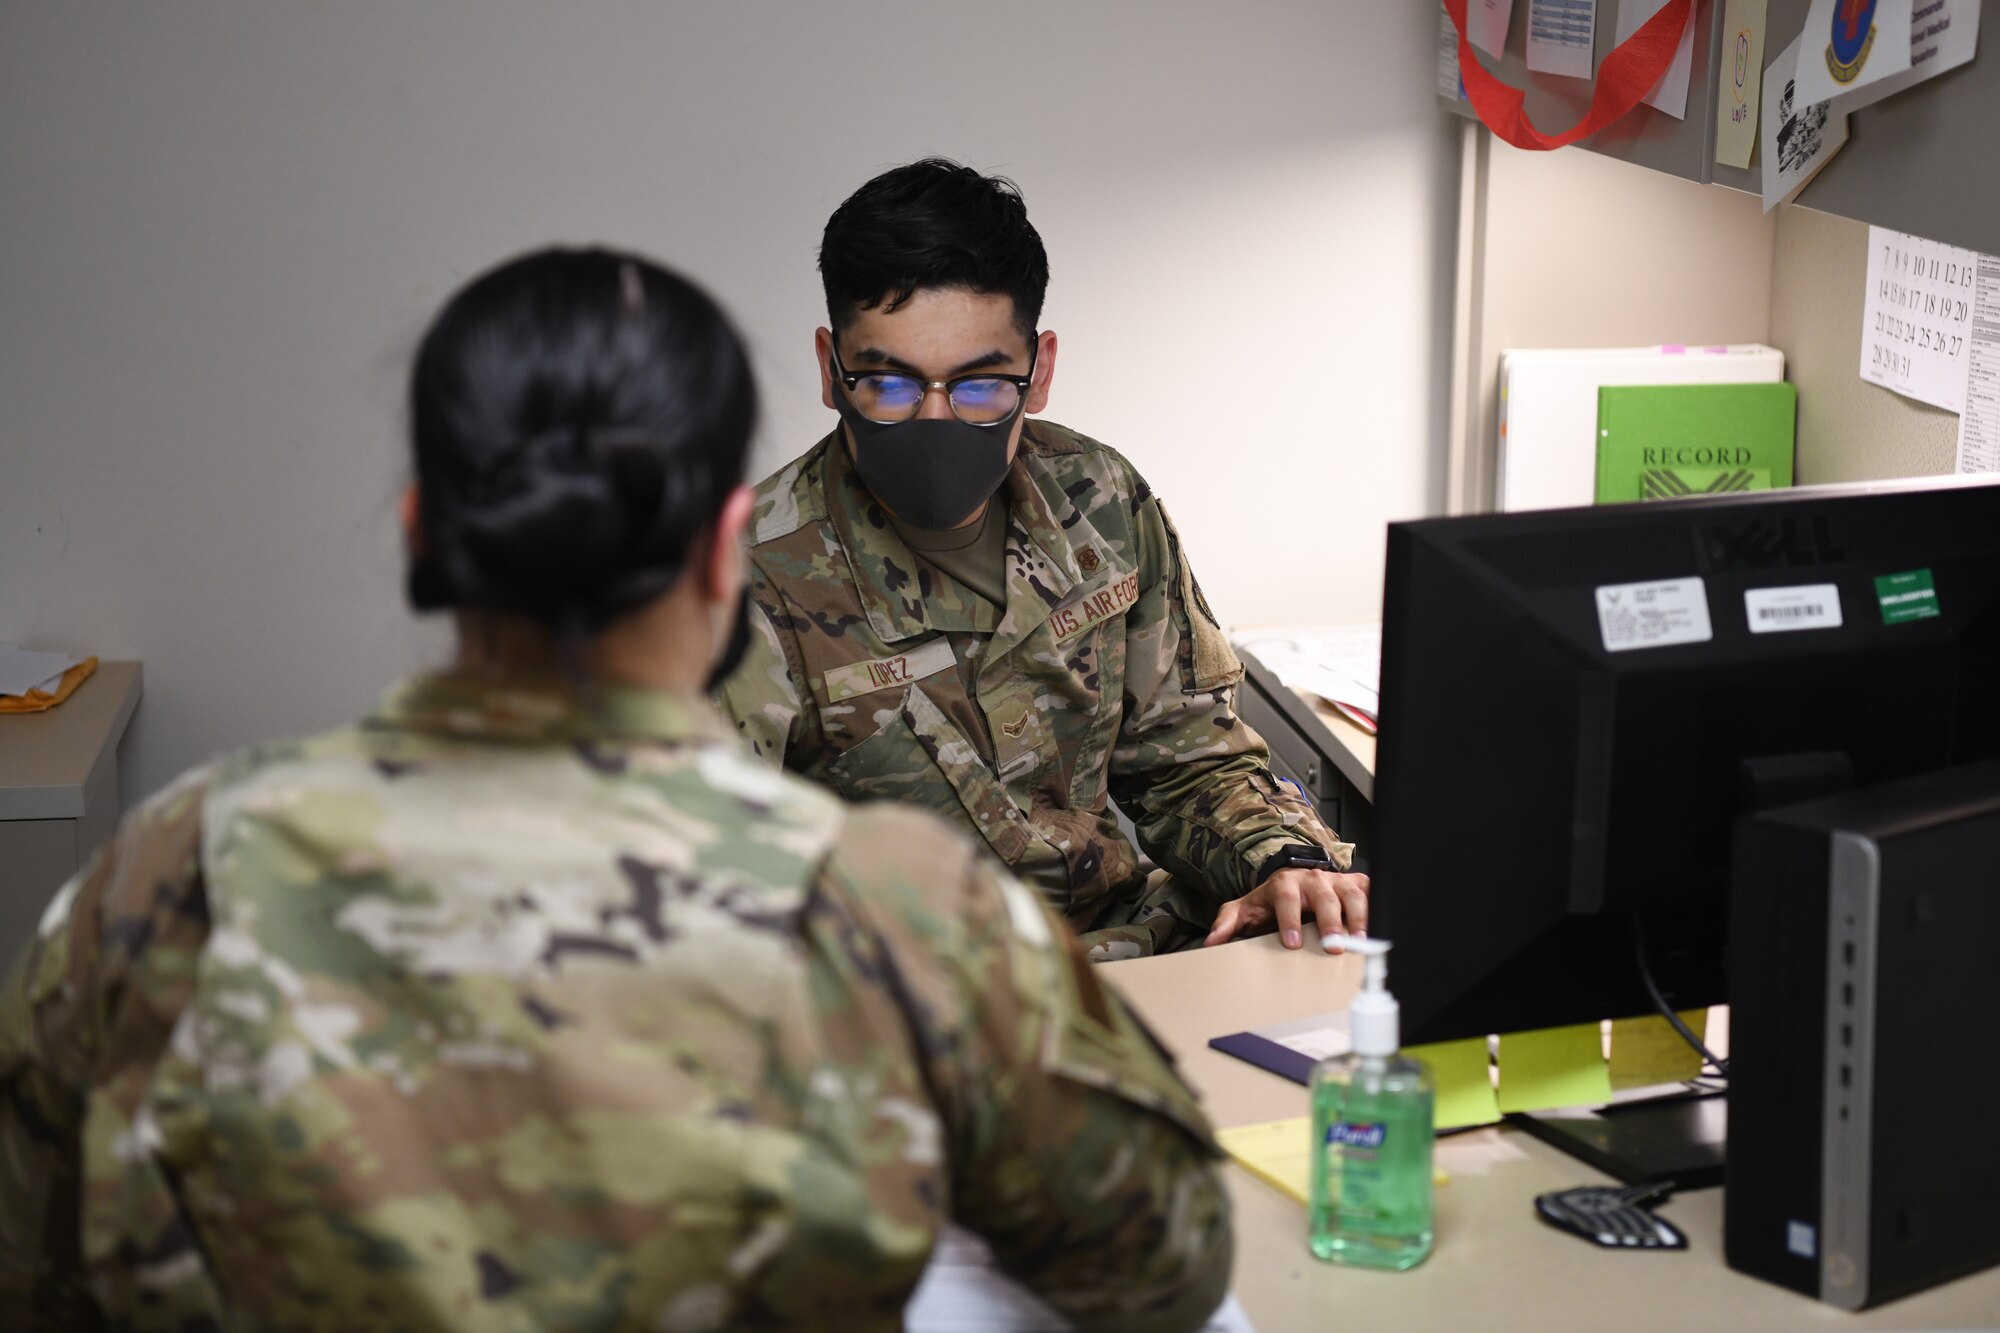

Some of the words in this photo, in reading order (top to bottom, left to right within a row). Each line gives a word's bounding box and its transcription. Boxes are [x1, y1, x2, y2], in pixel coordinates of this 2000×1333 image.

[1885, 246, 1890, 266] 7
[1894, 249, 1899, 269] 8
[1903, 252, 1909, 272] 9
[1914, 256, 1925, 276] 10
[1929, 260, 1940, 280] 11
[1944, 263, 1957, 284] 12
[1961, 267, 1972, 288] 13
[1880, 279, 1888, 300] 14
[1890, 282, 1898, 303] 15
[1898, 286, 1906, 306] 16
[1909, 290, 1921, 310] 17
[1924, 294, 1936, 314] 18
[1940, 298, 1952, 318] 19
[1954, 301, 1967, 322] 20
[1875, 311, 1884, 332] 21
[1887, 315, 1894, 336] 22
[1894, 319, 1902, 339] 23
[1904, 323, 1915, 344] 24
[1918, 327, 1931, 348] 25
[1933, 331, 1946, 352] 26
[1948, 335, 1962, 357] 27
[1872, 344, 1882, 364] 28
[1883, 348, 1891, 368] 29
[1892, 351, 1899, 373] 30
[1901, 356, 1910, 377] 31
[1643, 447, 1751, 466] RECORD
[1697, 515, 1846, 573] DELL
[1050, 609, 1082, 639] U.S.
[1082, 591, 1116, 622] AIR
[867, 657, 913, 687] LOPEZ
